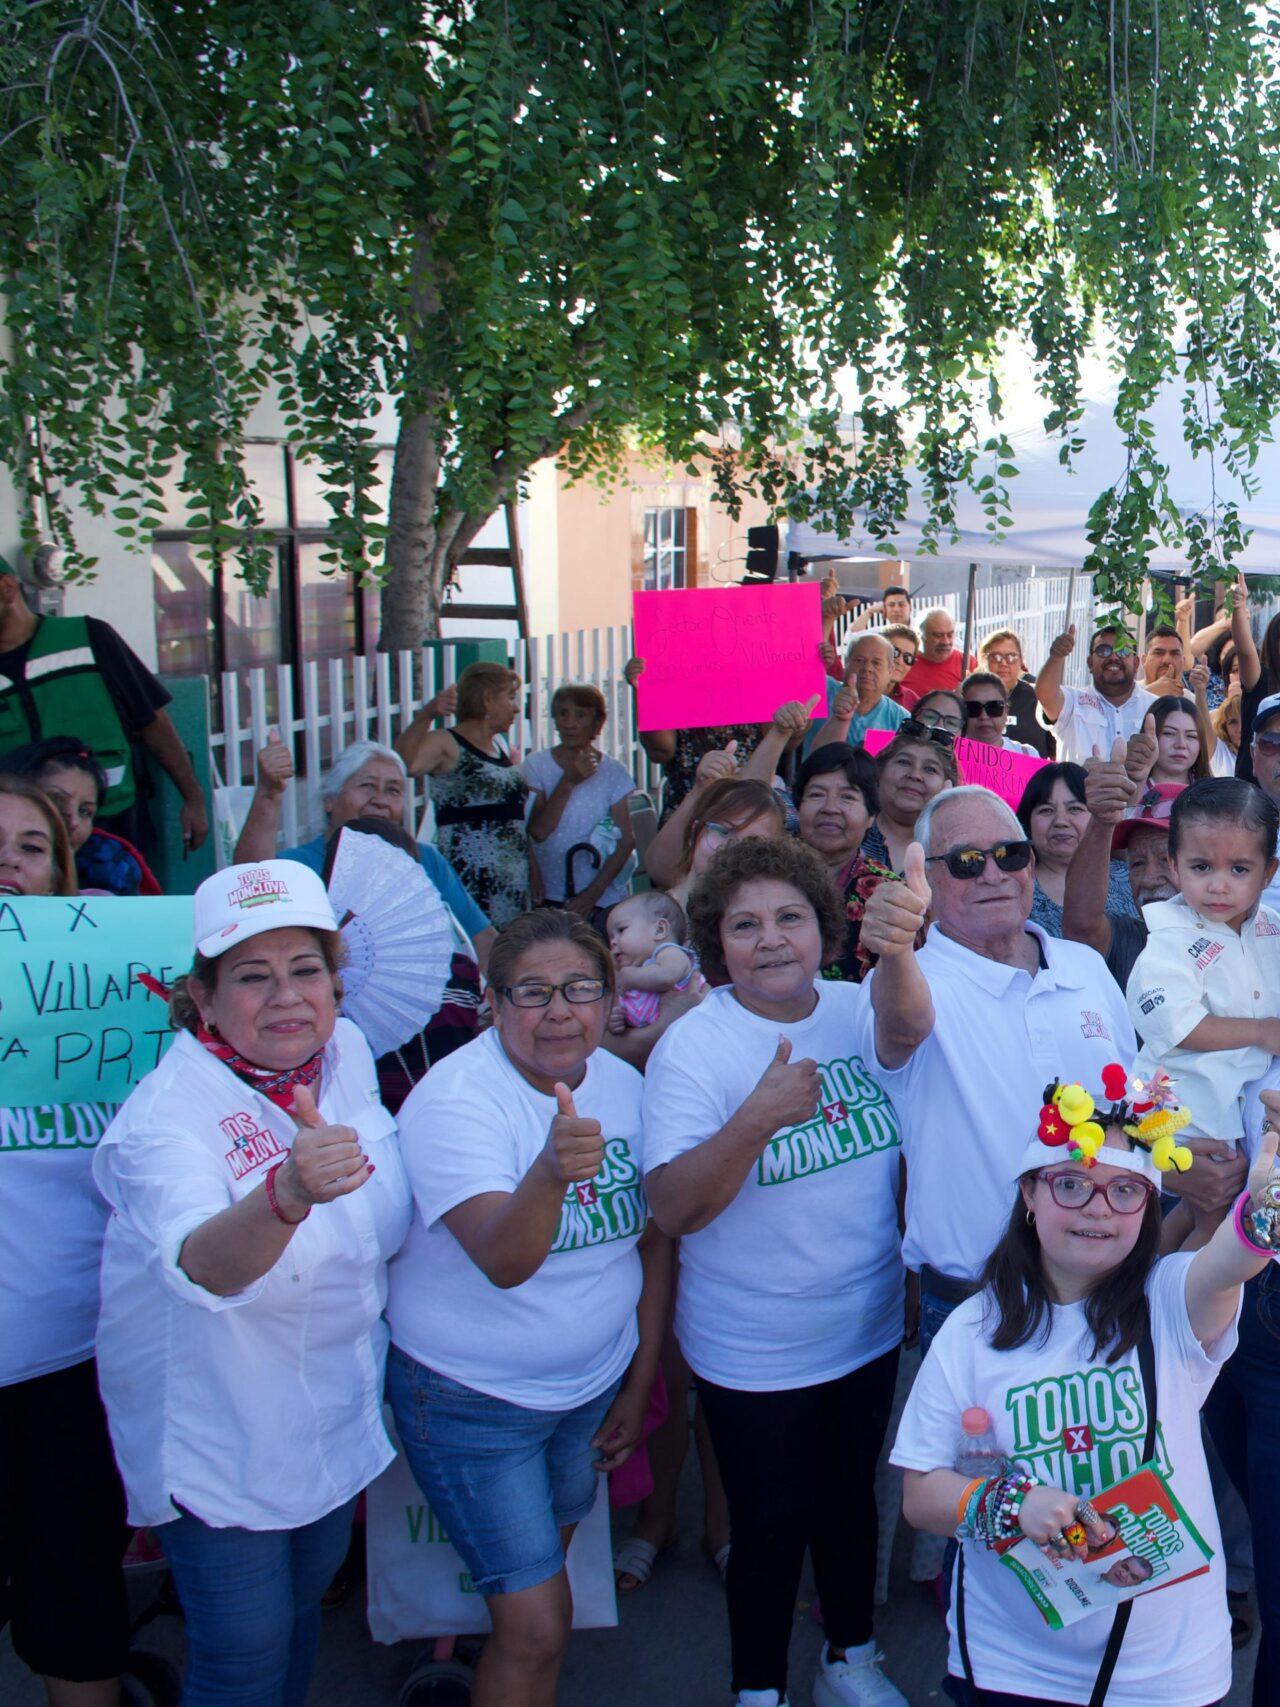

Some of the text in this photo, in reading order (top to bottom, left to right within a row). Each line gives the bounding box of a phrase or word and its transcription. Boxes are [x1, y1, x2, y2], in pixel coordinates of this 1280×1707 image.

[228, 881, 289, 906] MONCLOVA
[237, 869, 270, 887] TODOS
[759, 1099, 903, 1186] MONCLOV
[1007, 1367, 1146, 1451] TODOS
[1139, 1504, 1184, 1558] TODOS
[1064, 1576, 1092, 1608] RIQUELME
